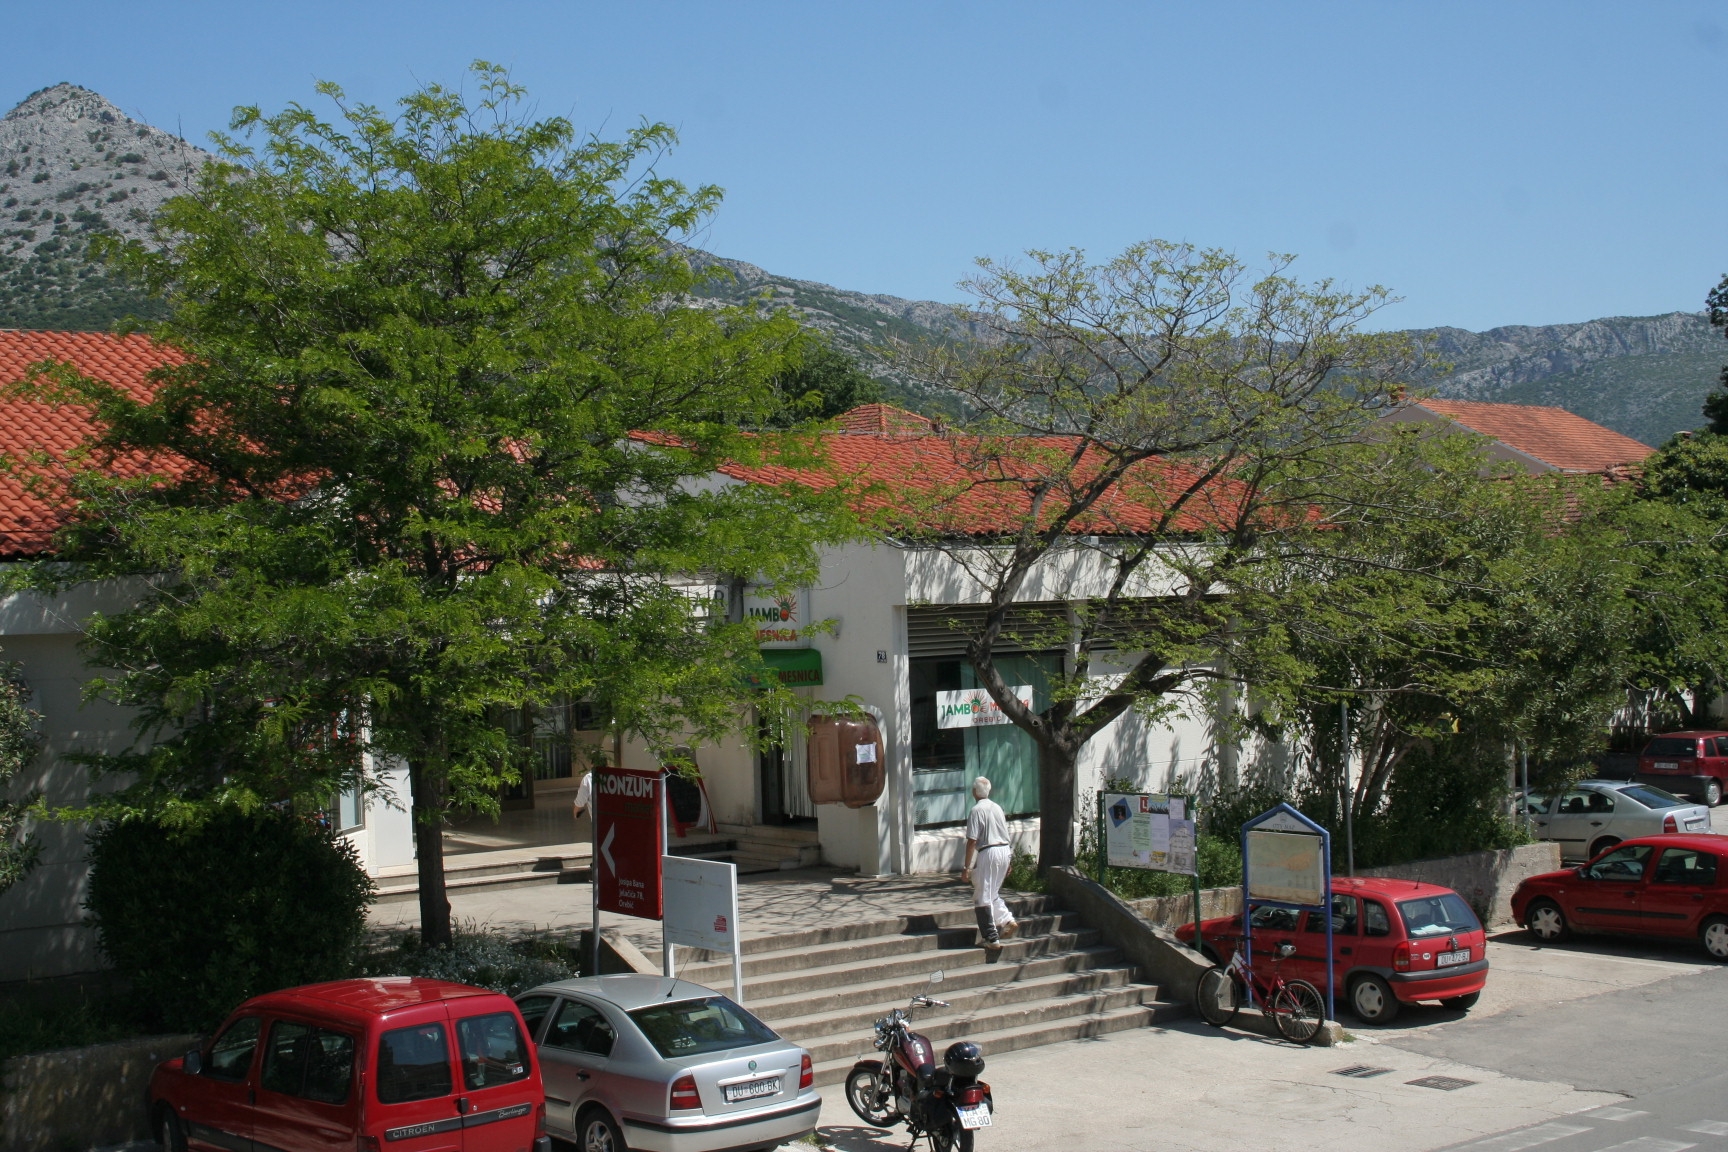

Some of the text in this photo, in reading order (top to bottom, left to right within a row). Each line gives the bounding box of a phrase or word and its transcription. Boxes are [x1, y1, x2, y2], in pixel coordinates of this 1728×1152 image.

[778, 669, 820, 683] MESNICA
[941, 699, 981, 718] JAMBO
[600, 774, 653, 799] KONZUM
[732, 1086, 744, 1098] DU
[498, 1107, 526, 1118] Berlingo
[977, 1115, 990, 1126] 80
